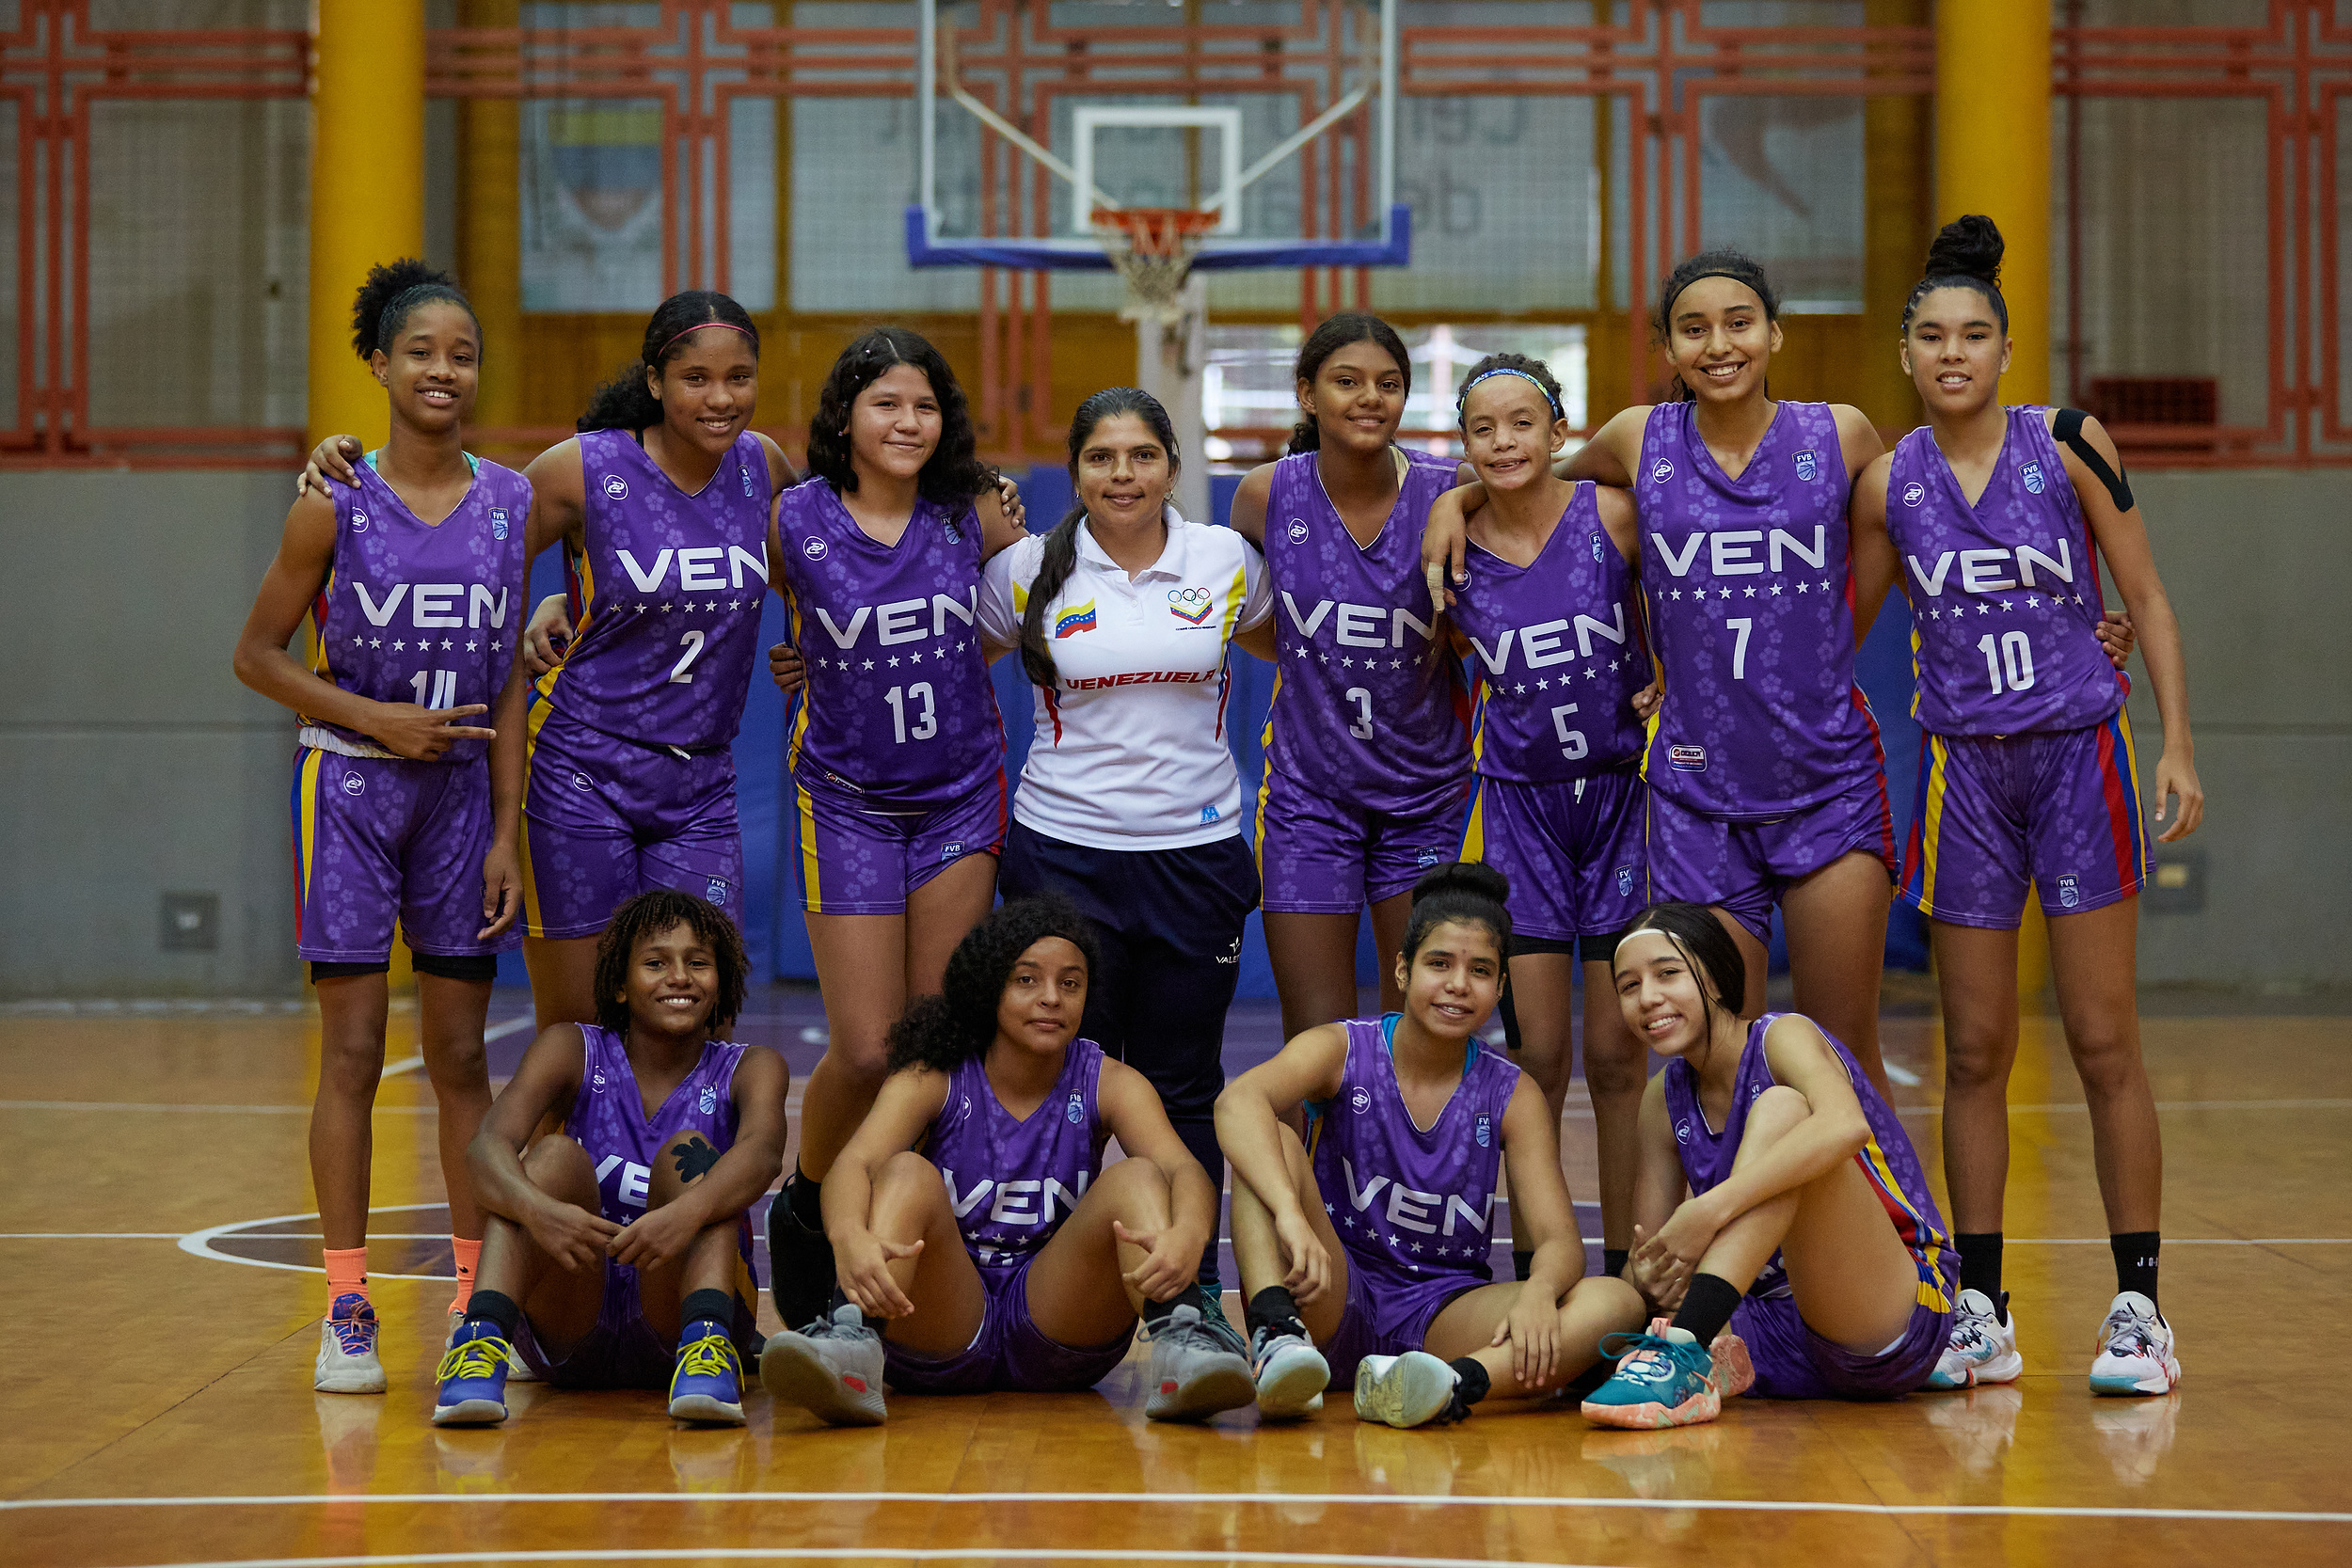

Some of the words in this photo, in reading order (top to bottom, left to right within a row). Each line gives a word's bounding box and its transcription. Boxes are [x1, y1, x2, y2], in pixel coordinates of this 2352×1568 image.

[1797, 452, 1812, 463] FVB
[2023, 464, 2038, 476] FVB
[615, 540, 770, 594] VEN
[1651, 524, 1825, 578] VEN
[1907, 537, 2074, 597] VEN
[352, 582, 508, 629] VEN
[816, 585, 977, 650] VEN
[1281, 590, 1438, 650] VEN
[669, 630, 706, 685] 2
[1469, 602, 1625, 675] VEN
[1726, 617, 1753, 680] 7
[1977, 630, 2037, 695] 10
[1065, 668, 1216, 690] VENEZUELA
[883, 681, 937, 745] 13
[1344, 687, 1374, 741] 3
[1550, 703, 1589, 760] 5
[945, 844, 961, 853] FVB
[1619, 870, 1629, 879] FV
[711, 879, 726, 888] FVB
[1478, 1117, 1490, 1126] FV
[595, 1153, 652, 1209] VE
[942, 1166, 1089, 1227] VEN
[1341, 1155, 1496, 1238] VEN
